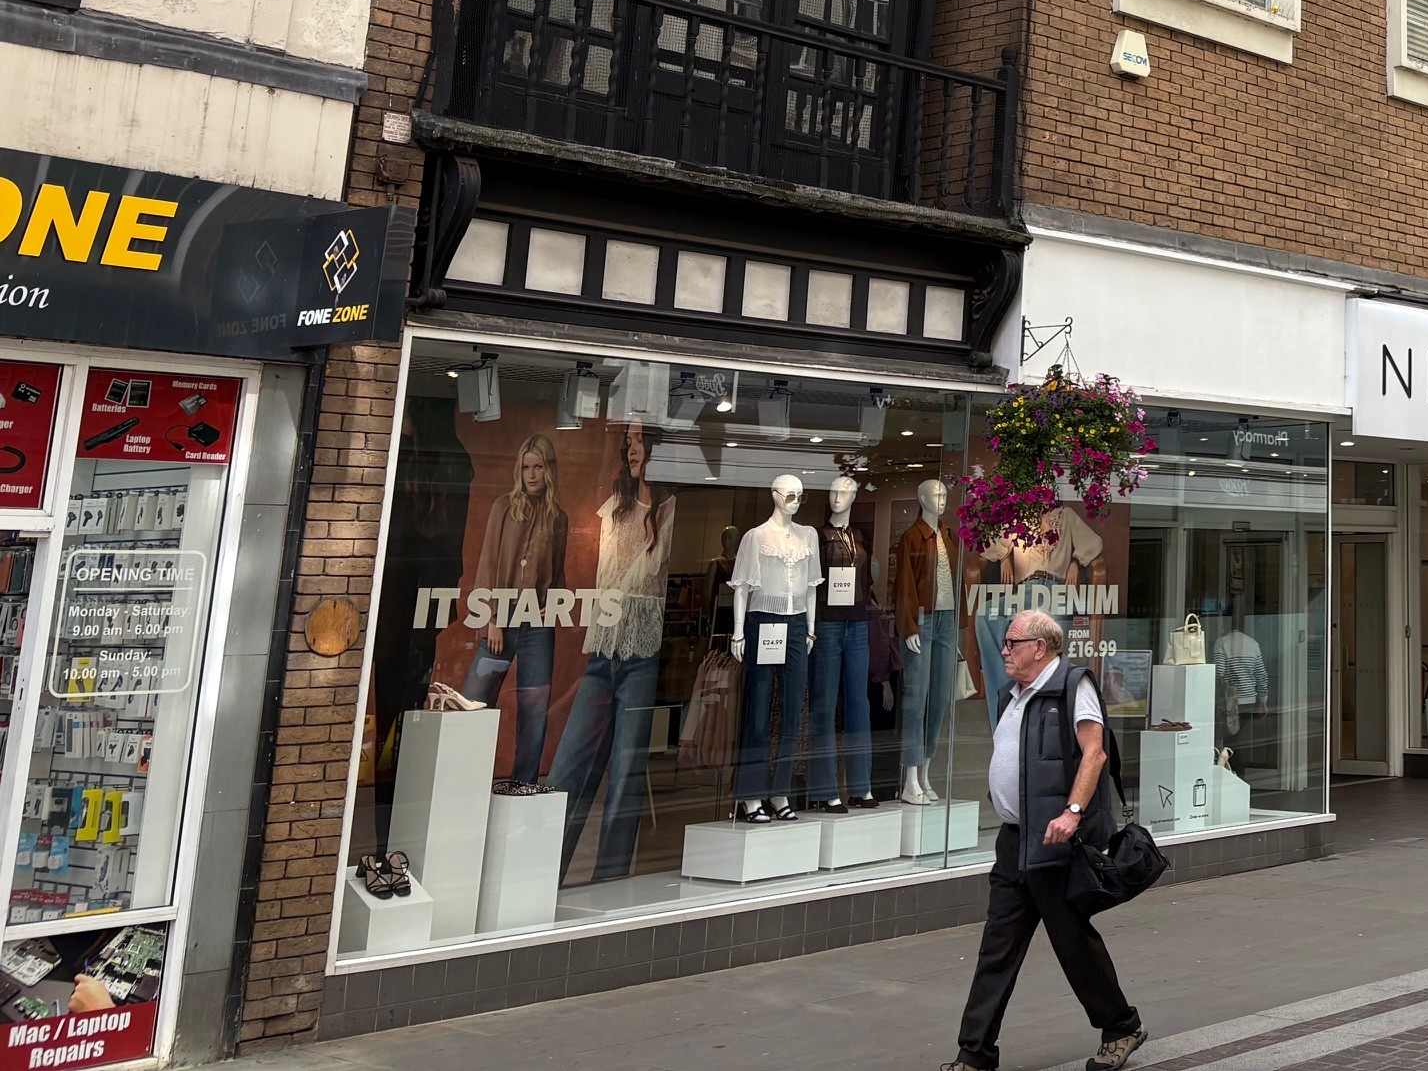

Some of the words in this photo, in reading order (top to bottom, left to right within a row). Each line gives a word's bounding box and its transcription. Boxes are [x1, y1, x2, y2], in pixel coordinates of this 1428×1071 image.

[1123, 52, 1147, 66] SECOM
[297, 308, 333, 327] FONE
[331, 304, 370, 323] ZONE
[172, 380, 198, 390] Memory
[198, 382, 217, 391] Cards
[92, 403, 127, 414] Batteries
[125, 434, 151, 444] Laptop
[123, 444, 151, 455] Battery
[185, 451, 202, 460] Card
[202, 452, 226, 461] Reader
[0, 484, 34, 495] Charger
[76, 567, 152, 582] OPENING
[158, 568, 195, 582] TIME
[1031, 584, 1119, 616] DENIM
[68, 606, 120, 619] Monday
[131, 605, 192, 618] Saturday:
[412, 587, 462, 629] IT
[462, 587, 624, 629] STARTS
[72, 624, 99, 637] 9.00
[103, 626, 123, 636] am
[134, 623, 160, 635] 6.00
[163, 625, 183, 637] pm
[1068, 629, 1090, 639] FROM
[99, 649, 152, 663] Sunday:
[1067, 640, 1117, 659] £16.99
[63, 668, 97, 680] 10.00
[100, 670, 120, 679] am
[132, 666, 158, 677] 5.00
[161, 668, 181, 679] pm
[7, 1020, 51, 1049] Mac
[53, 1017, 66, 1041] /
[67, 1010, 132, 1041] Laptop
[28, 1037, 106, 1070] Repairs
